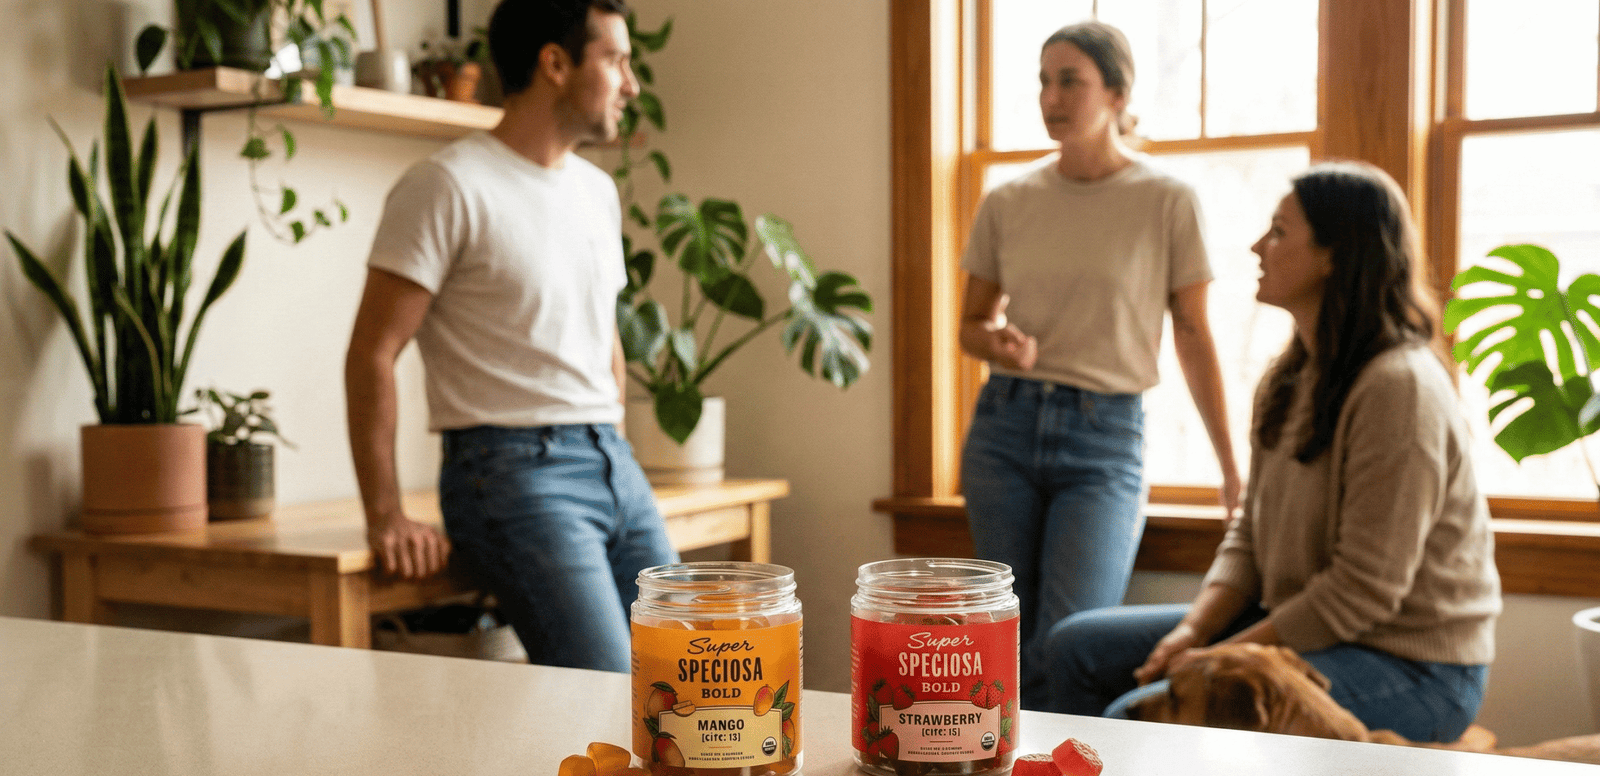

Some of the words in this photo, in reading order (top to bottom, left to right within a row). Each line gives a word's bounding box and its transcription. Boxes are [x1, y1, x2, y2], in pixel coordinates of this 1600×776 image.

[687, 637, 754, 656] Super
[907, 632, 974, 650] Super
[678, 657, 763, 683] SPECIOSA
[898, 652, 983, 677] SPECIOSA
[701, 688, 741, 699] BOLD
[922, 682, 961, 693] BOLD
[698, 719, 745, 731] MANGO
[899, 713, 982, 726] STRAWBERRY
